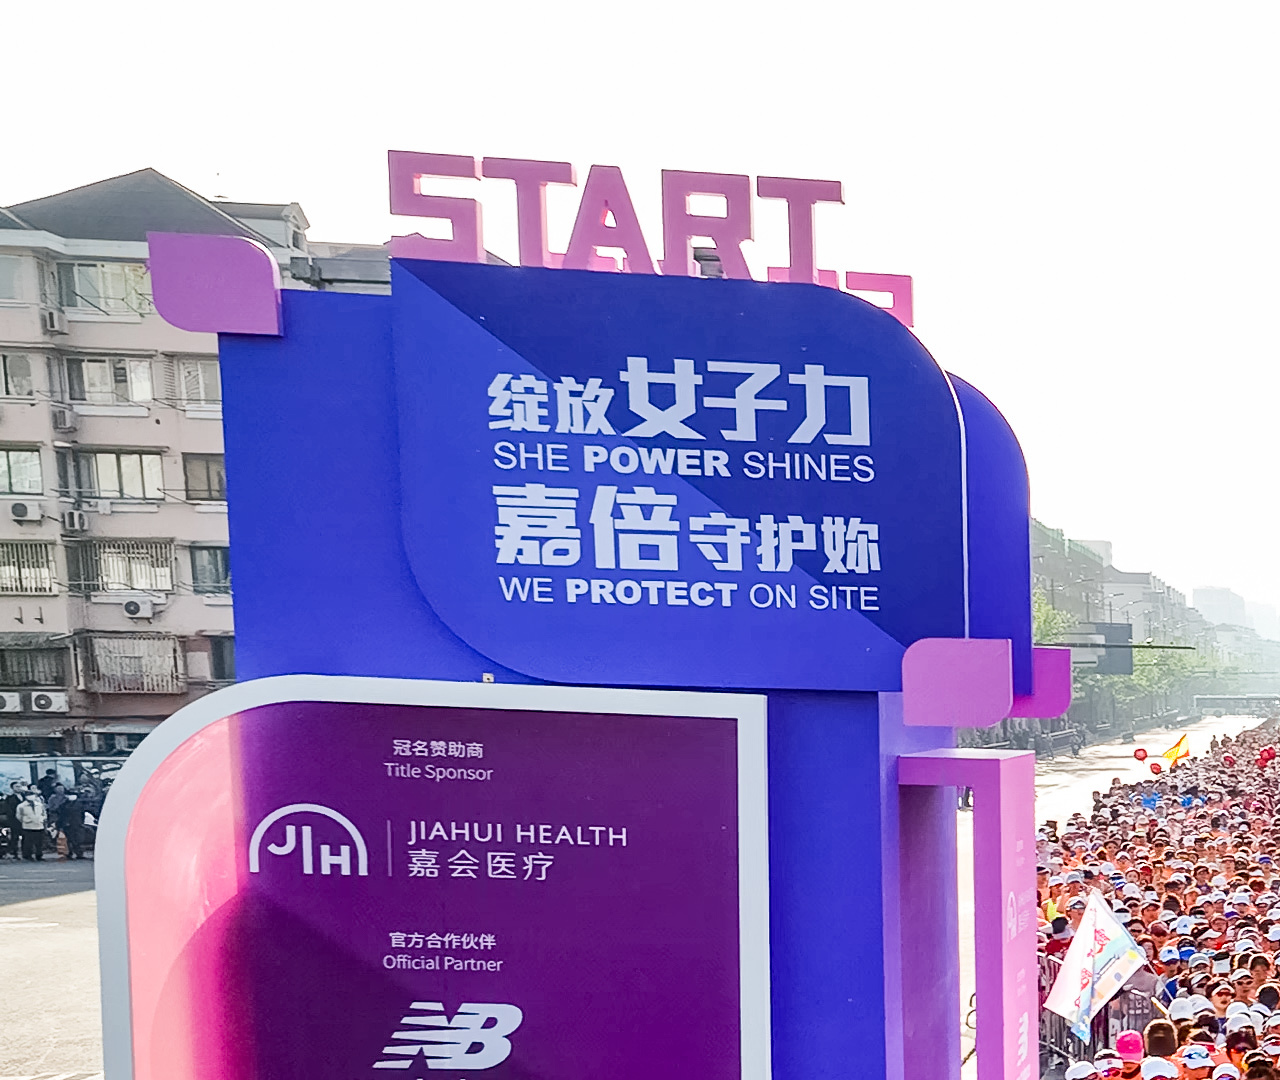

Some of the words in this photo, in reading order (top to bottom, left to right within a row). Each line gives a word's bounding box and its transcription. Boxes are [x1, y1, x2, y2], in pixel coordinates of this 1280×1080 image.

[388, 150, 844, 285] START
[486, 355, 871, 446] 绽放女子力
[493, 442, 569, 471] SHE
[584, 446, 731, 477] POWER
[741, 451, 875, 483] SHINES
[493, 484, 881, 575] 嘉倍守护妳
[499, 577, 555, 604] WE
[566, 579, 737, 608] PROTECT
[750, 583, 798, 610] ON
[808, 584, 880, 612] SITE
[392, 739, 484, 759] 冠名赞助商
[383, 763, 421, 779] Title
[424, 764, 494, 782] Sponsor
[408, 819, 503, 845] JIAHUI
[517, 824, 627, 848] HEALTH
[407, 848, 555, 881] 嘉会医疗
[388, 932, 496, 951] 官方合作伙伴
[382, 955, 441, 971] Official
[443, 956, 503, 972] Partner
